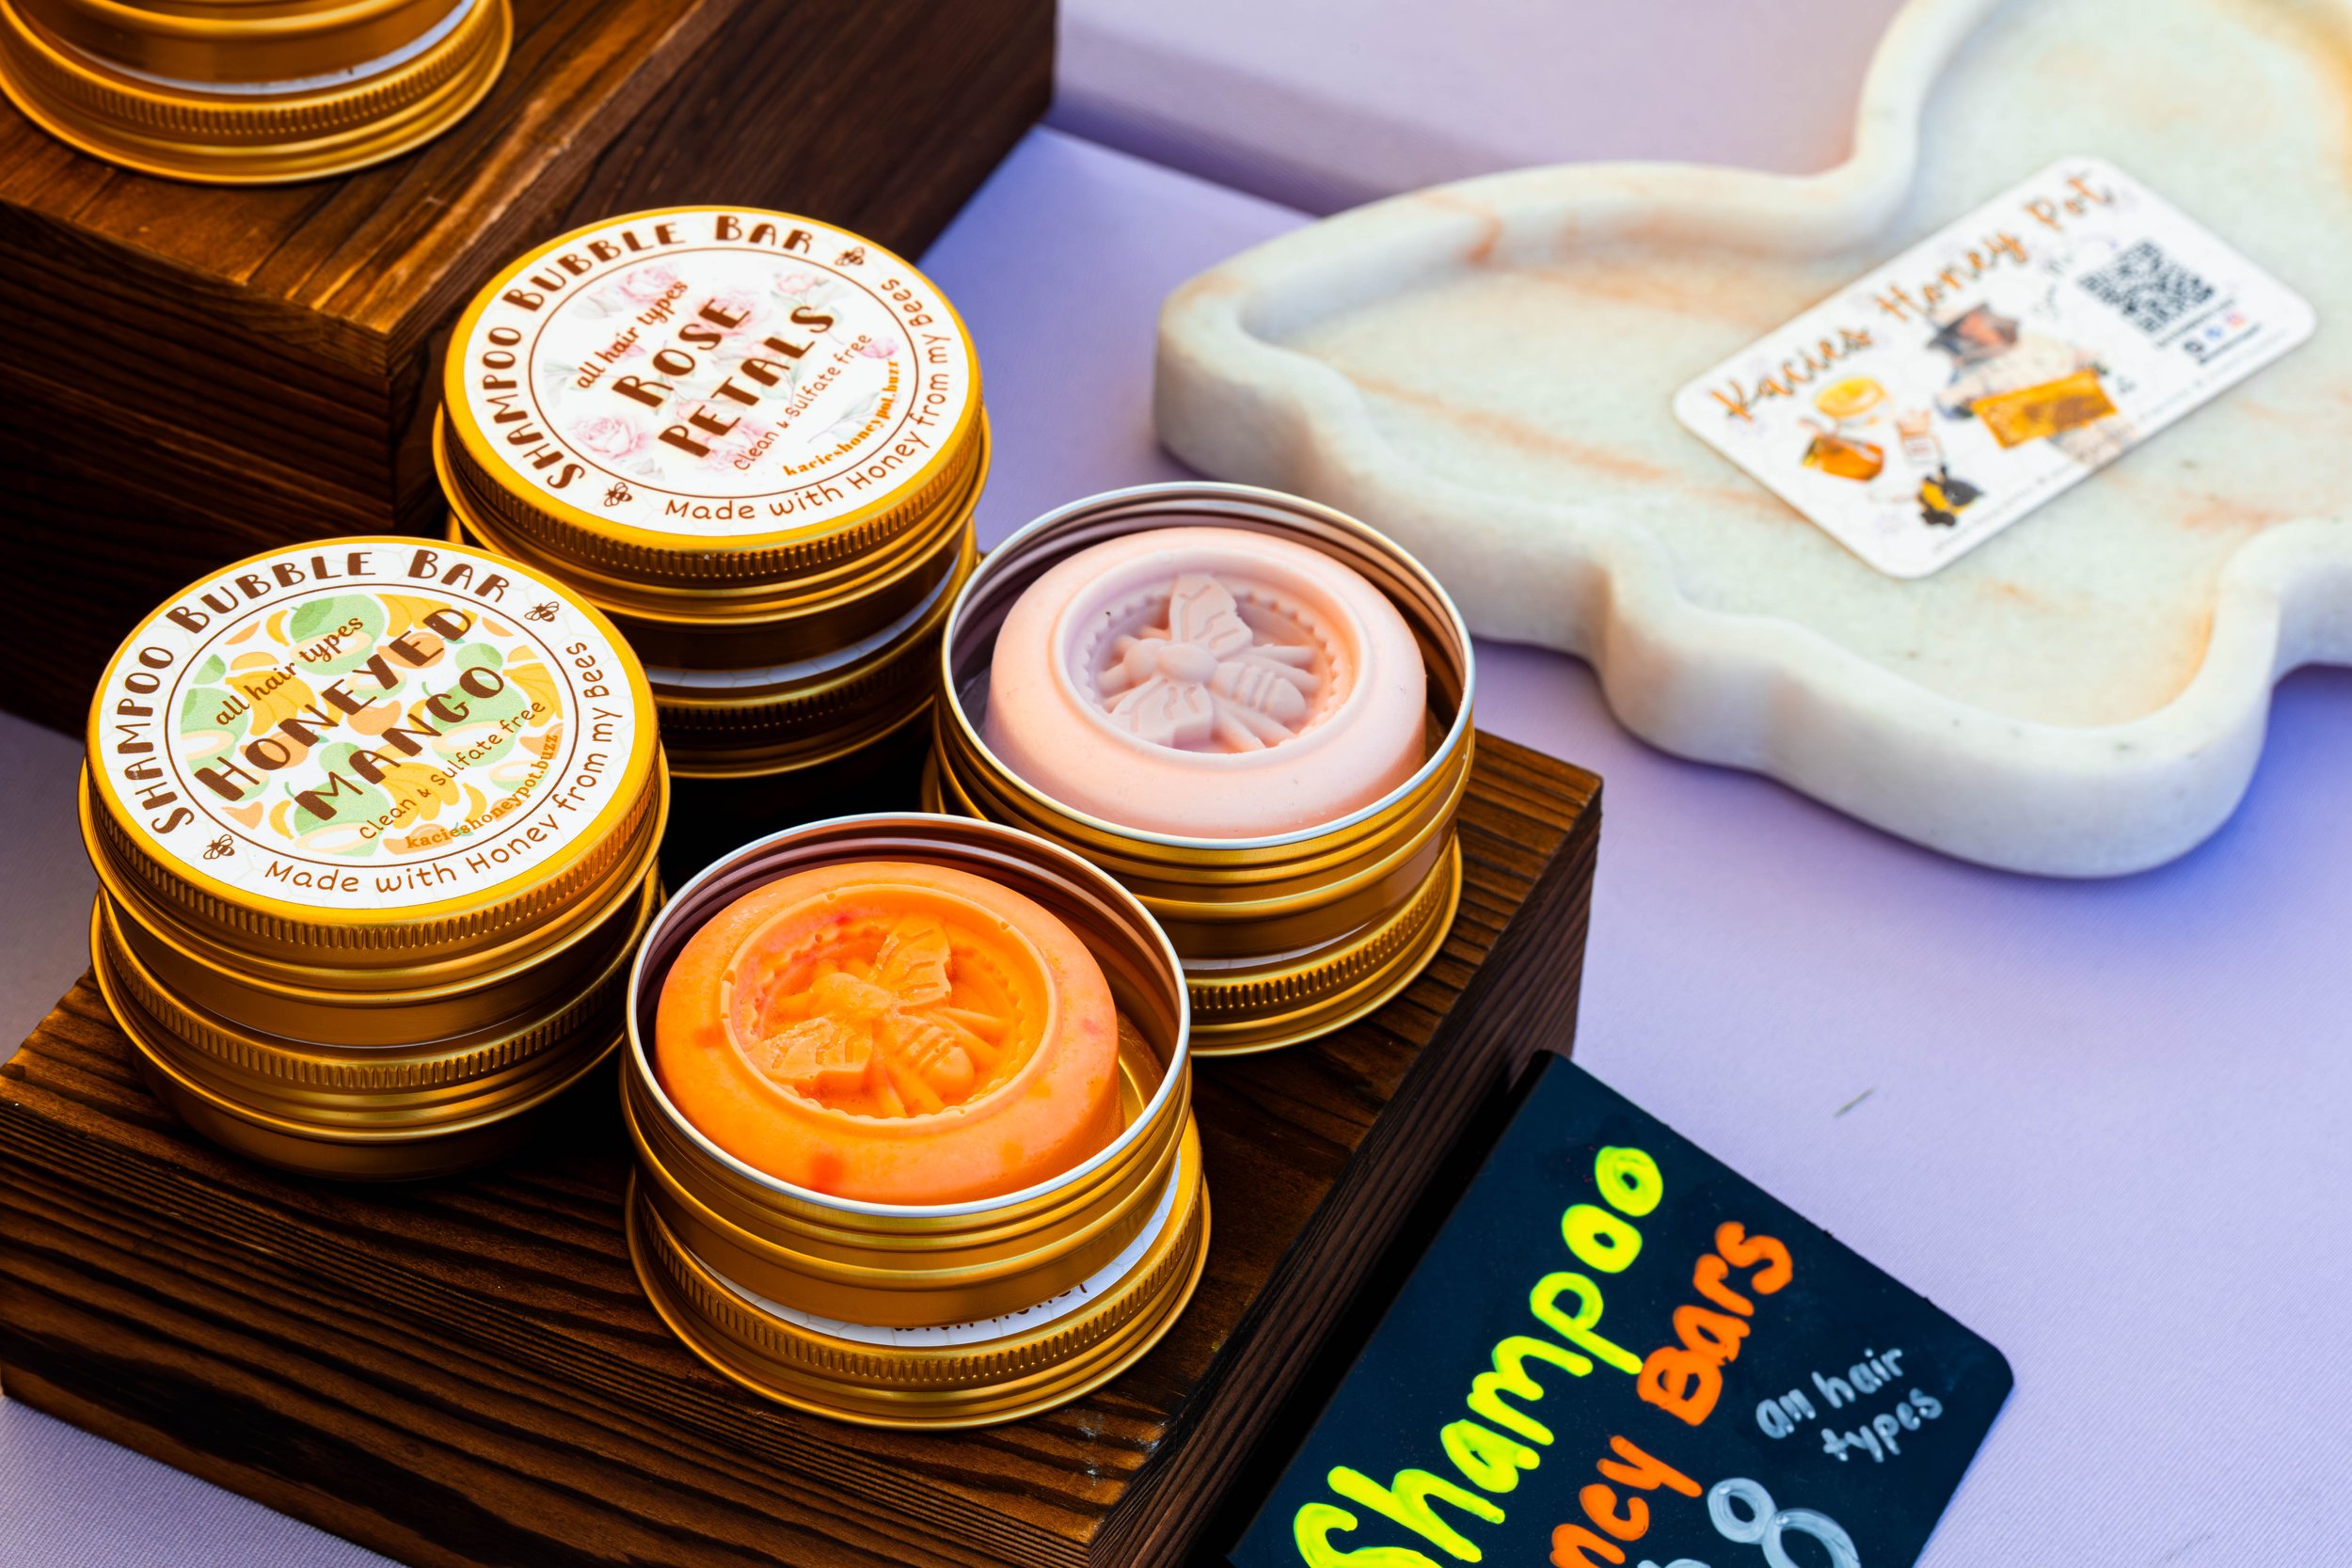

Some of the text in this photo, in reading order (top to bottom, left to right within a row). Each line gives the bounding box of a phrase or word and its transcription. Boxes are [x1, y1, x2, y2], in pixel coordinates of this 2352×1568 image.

[1876, 231, 2029, 322] Honey
[2024, 175, 2114, 231] Pot
[483, 215, 814, 490] SHAMPOO BUBBLE BAR
[577, 281, 690, 390] all hair types
[612, 298, 752, 408] ROSE
[658, 306, 834, 458] PETALS
[664, 278, 951, 521] Made with Honey from my Bees
[833, 333, 872, 365] free
[783, 360, 899, 477] kacieshoneypot.buzz
[117, 548, 510, 835] SHAMPOO BUBBLE BAR
[194, 607, 472, 802] HONEYED
[215, 617, 363, 727] all hair types
[499, 702, 547, 734] free
[264, 641, 623, 894] Made with Honey from my Bees
[294, 666, 504, 821] MANGO
[406, 735, 558, 849] kacieshoneypot.buzz
[1637, 1221, 1794, 1426] Bars
[1756, 1348, 1902, 1438] all hair
[1820, 1387, 1943, 1463] types
